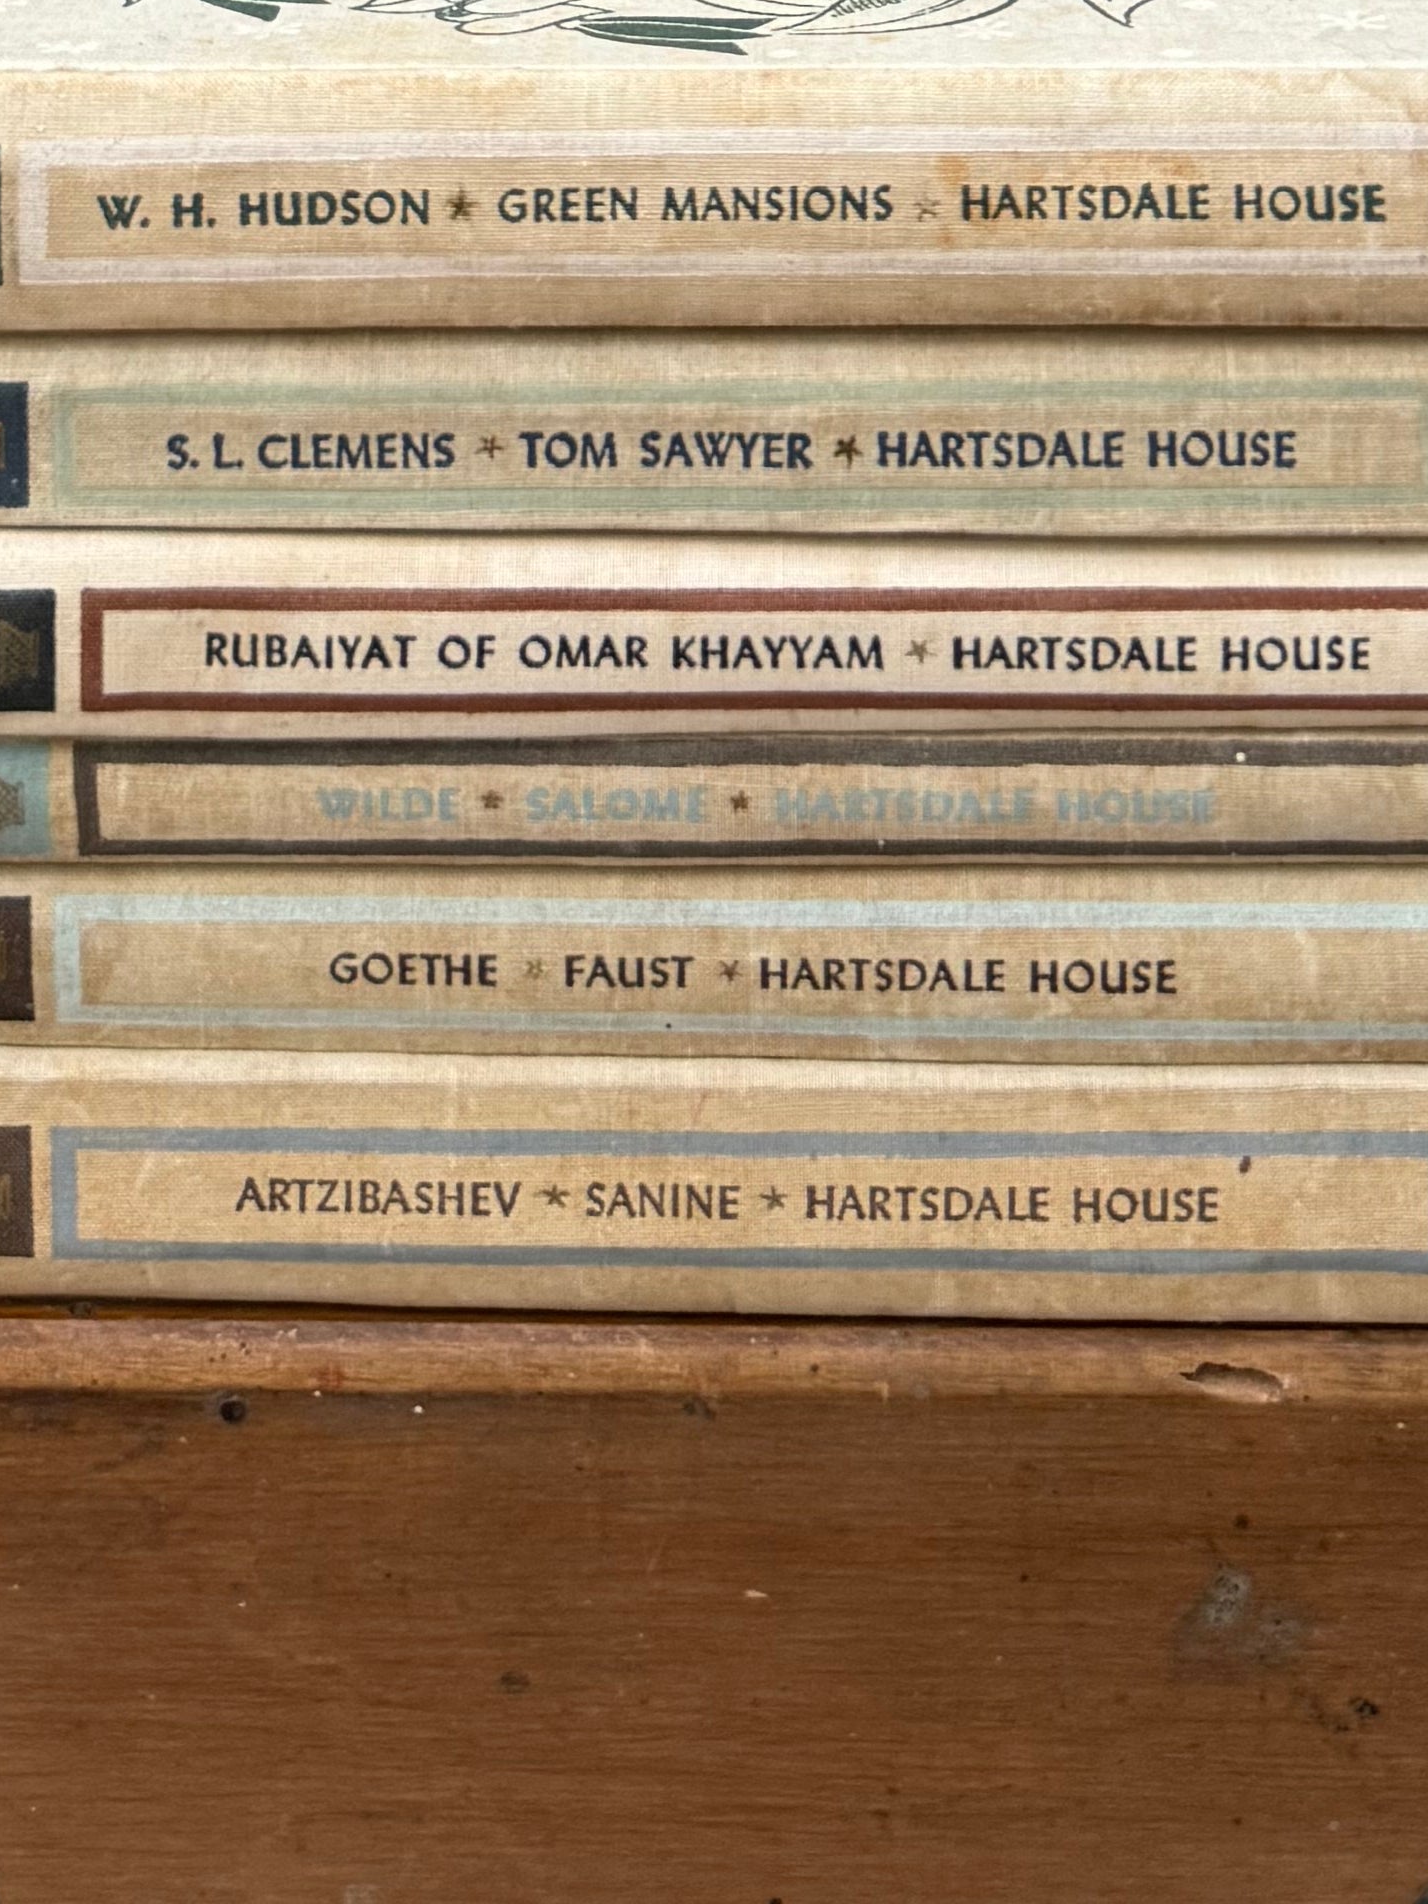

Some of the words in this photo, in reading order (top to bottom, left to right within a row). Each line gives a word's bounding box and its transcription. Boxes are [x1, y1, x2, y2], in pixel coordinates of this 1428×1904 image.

[97, 194, 151, 231] W.
[172, 193, 217, 229] H.
[239, 189, 431, 228] HUDSON
[498, 187, 638, 224] GREEN
[662, 184, 894, 223] MANSIONS
[960, 182, 1211, 221] HARTSDALE
[1235, 182, 1387, 223] HOUSE
[166, 434, 201, 471] S.
[212, 434, 244, 471] L.
[258, 434, 456, 471] CLEMENS
[519, 432, 617, 470] TOM
[640, 432, 813, 470] SAWYER
[876, 431, 1126, 470] HARTSDALE
[1147, 431, 1298, 470] HOUSE
[205, 632, 416, 671] RUBAIYAT
[436, 634, 496, 671] OF
[518, 633, 648, 671] OMAR
[671, 633, 884, 671] KHAYYAM
[952, 635, 1199, 674] HARTSDALE
[1220, 636, 1371, 674] HOUSE
[316, 785, 460, 824] WILDE
[774, 786, 1034, 826] HARTSDALE
[1056, 785, 1213, 825] HOUSE
[329, 951, 499, 988] GOETHE
[564, 954, 694, 990] FAUST
[759, 957, 1006, 995] HARTSDALE
[1030, 958, 1177, 996] HOUSE
[236, 1178, 521, 1218] ARTZIBASHEV
[584, 1181, 740, 1221] SANINE
[805, 1183, 1050, 1223] HARTSDALE
[1072, 1185, 1220, 1225] HOUSE
